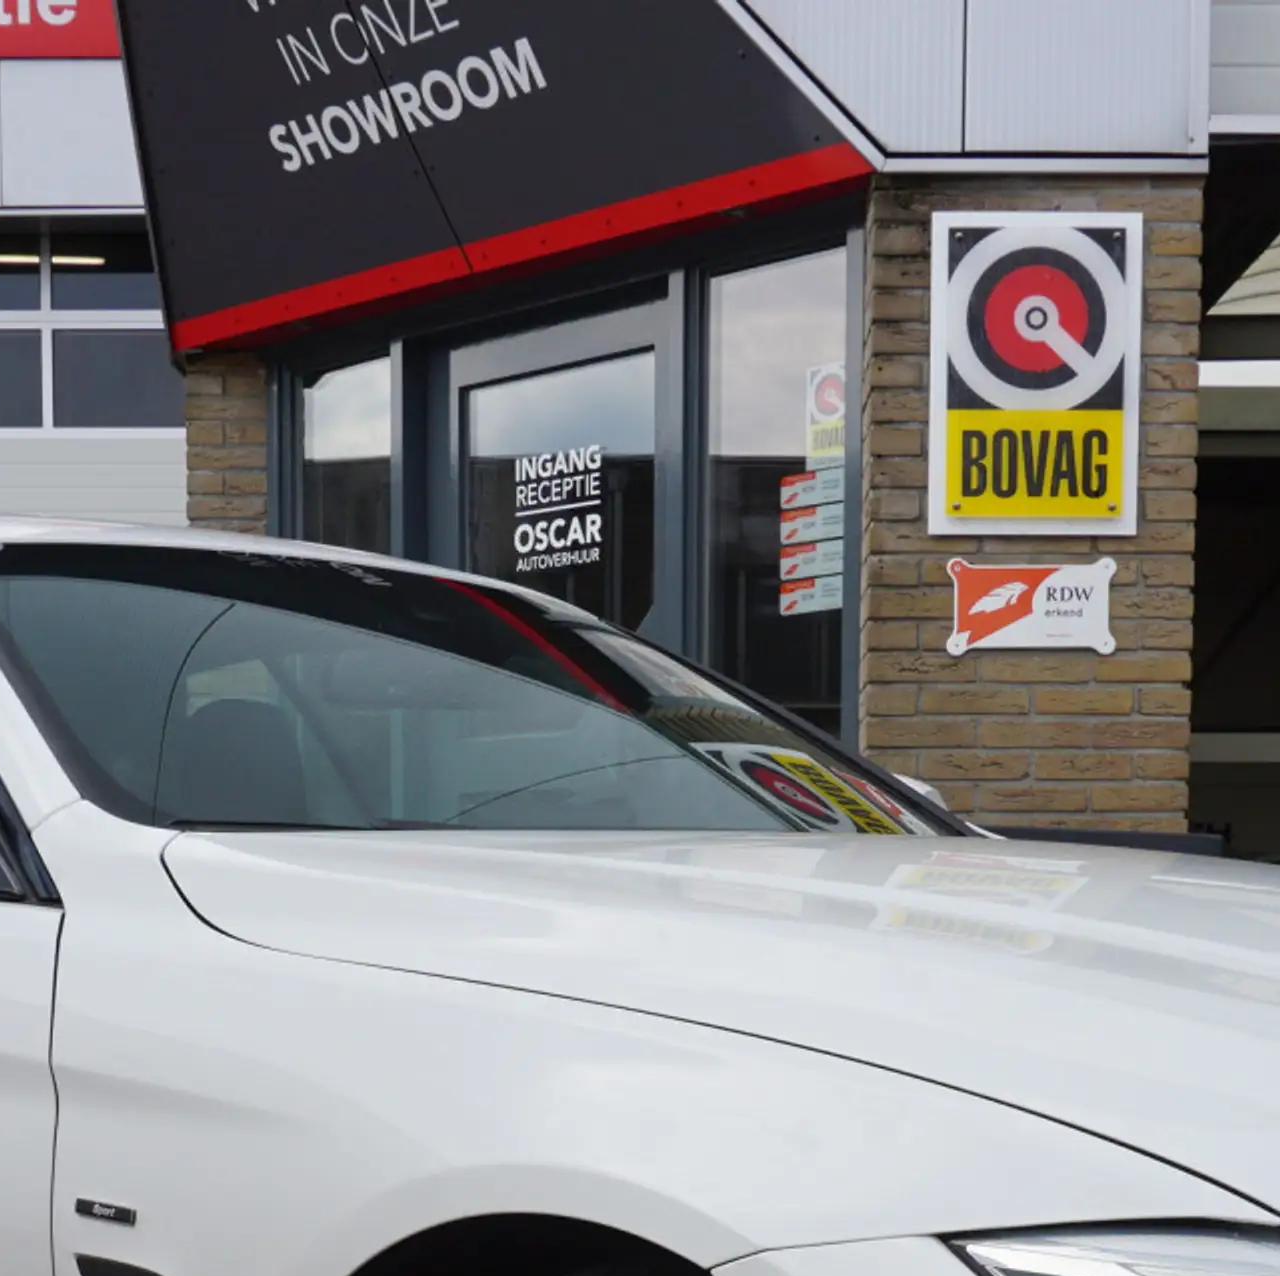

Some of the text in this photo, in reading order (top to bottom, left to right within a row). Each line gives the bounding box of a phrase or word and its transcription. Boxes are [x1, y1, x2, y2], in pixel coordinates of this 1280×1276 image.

[275, 0, 461, 86] IN ONZE
[268, 36, 548, 173] SHOWROOM
[515, 444, 602, 482] INGANG
[960, 428, 1109, 500] BOVAG
[515, 471, 601, 508] RECEPTIE
[513, 513, 602, 554] OSCAR
[516, 547, 600, 573] AUTOVERHUUR
[1044, 607, 1084, 618] erkend
[1045, 585, 1095, 603] RDW
